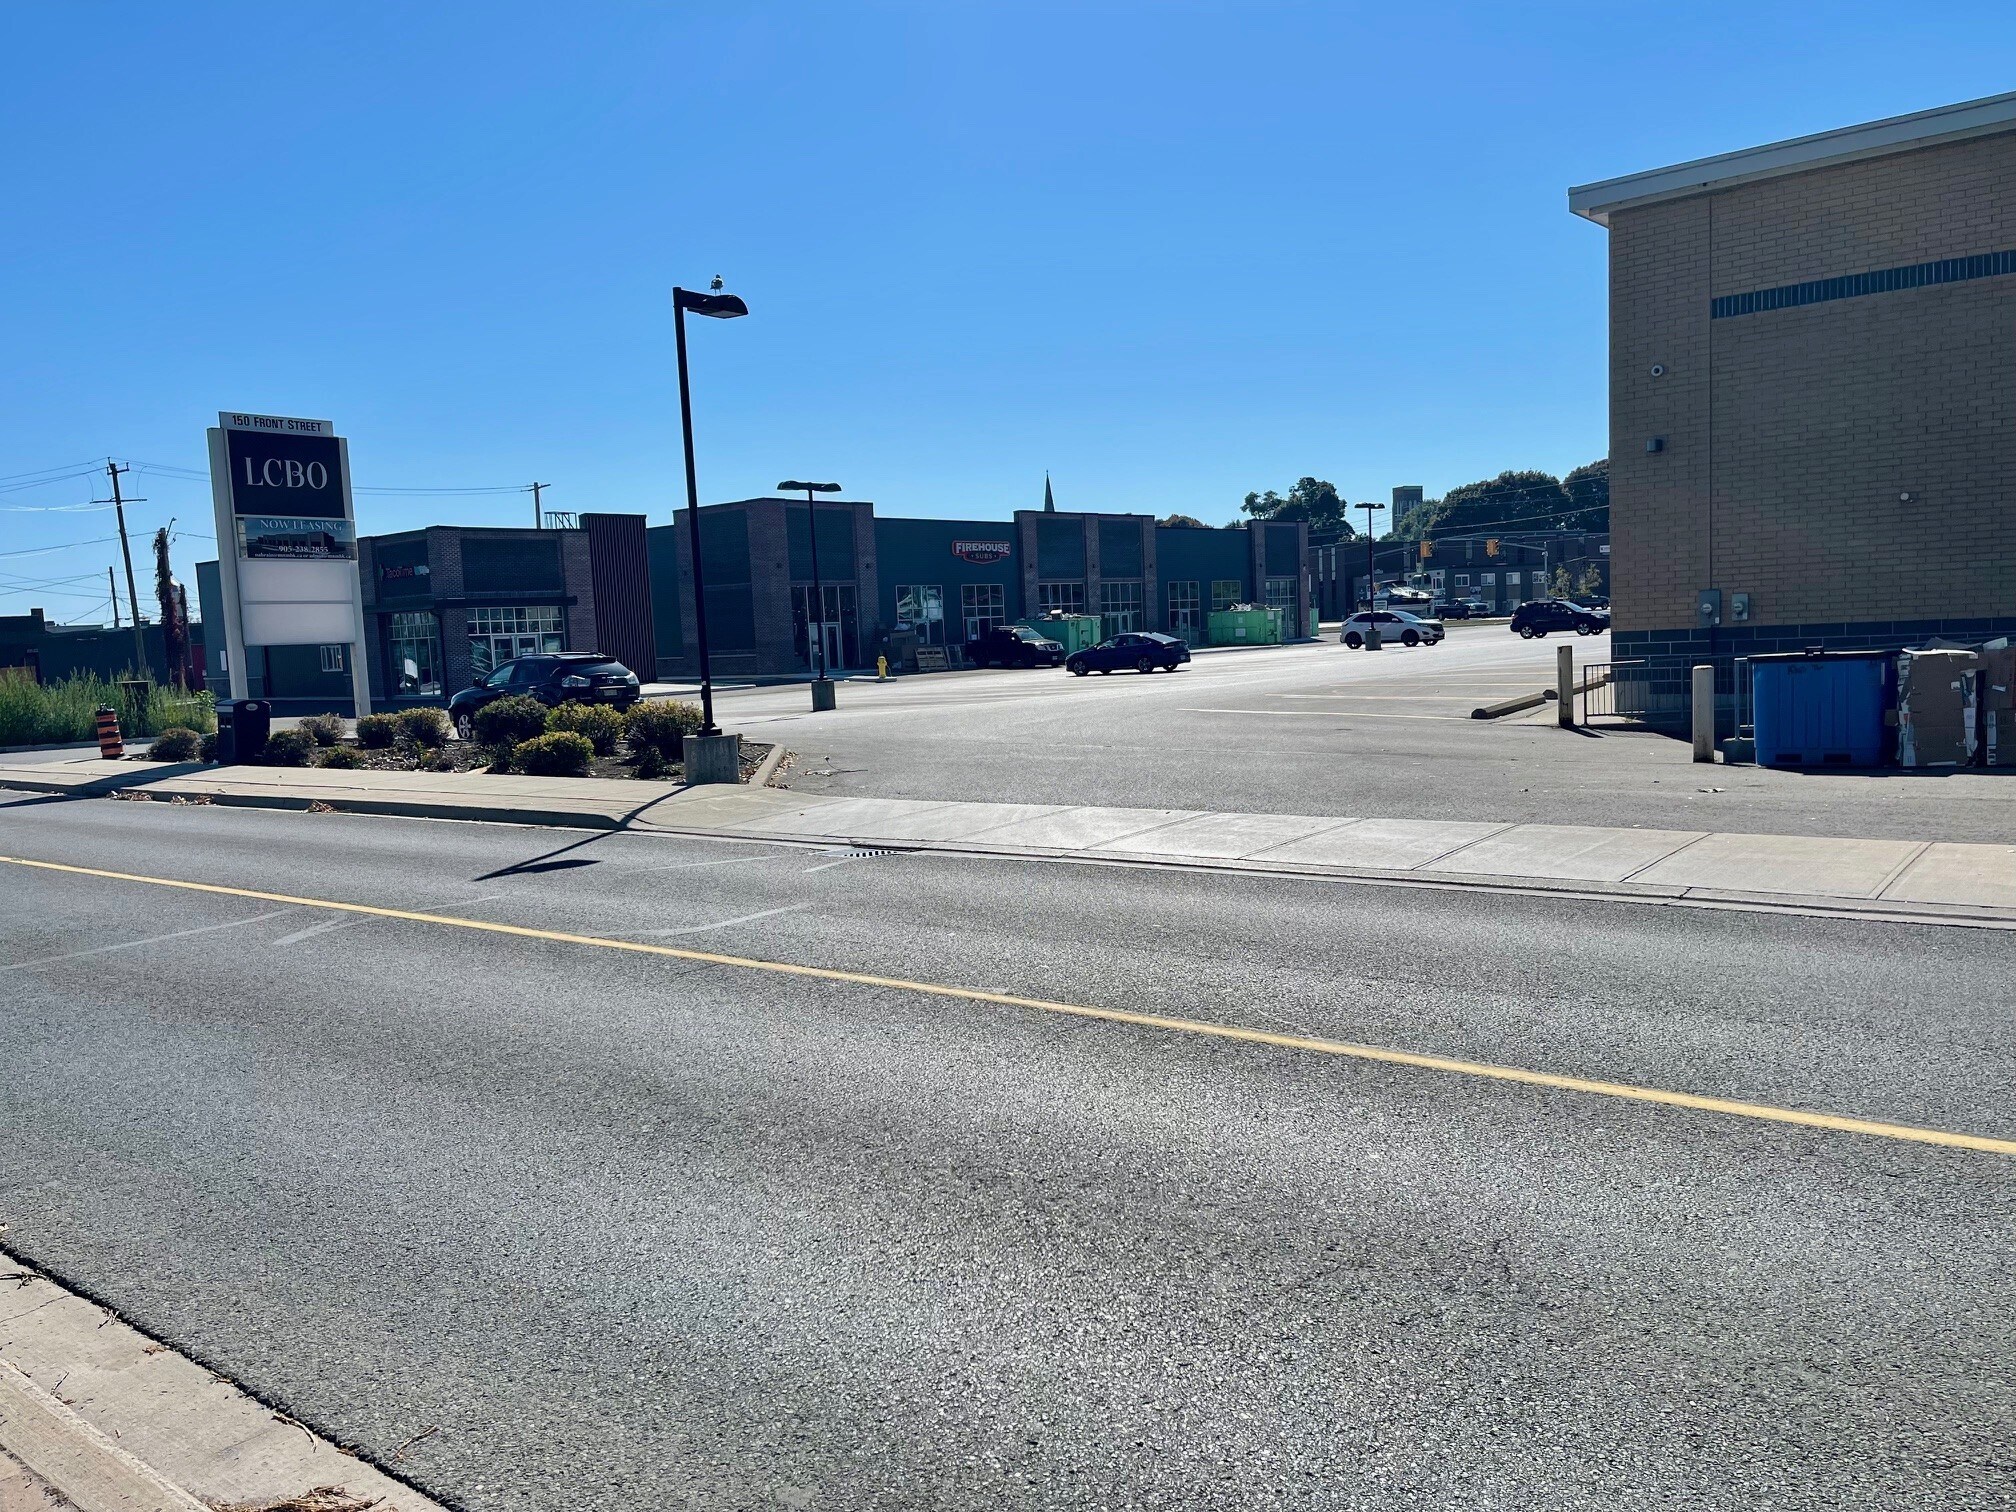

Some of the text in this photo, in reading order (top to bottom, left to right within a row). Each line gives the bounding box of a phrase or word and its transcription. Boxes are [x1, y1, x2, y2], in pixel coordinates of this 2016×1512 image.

[232, 415, 322, 432] 150 FRONT STREET
[244, 456, 328, 490] LCBO
[260, 519, 343, 531] NOW LEASING
[955, 542, 1010, 554] FIREHOUSE
